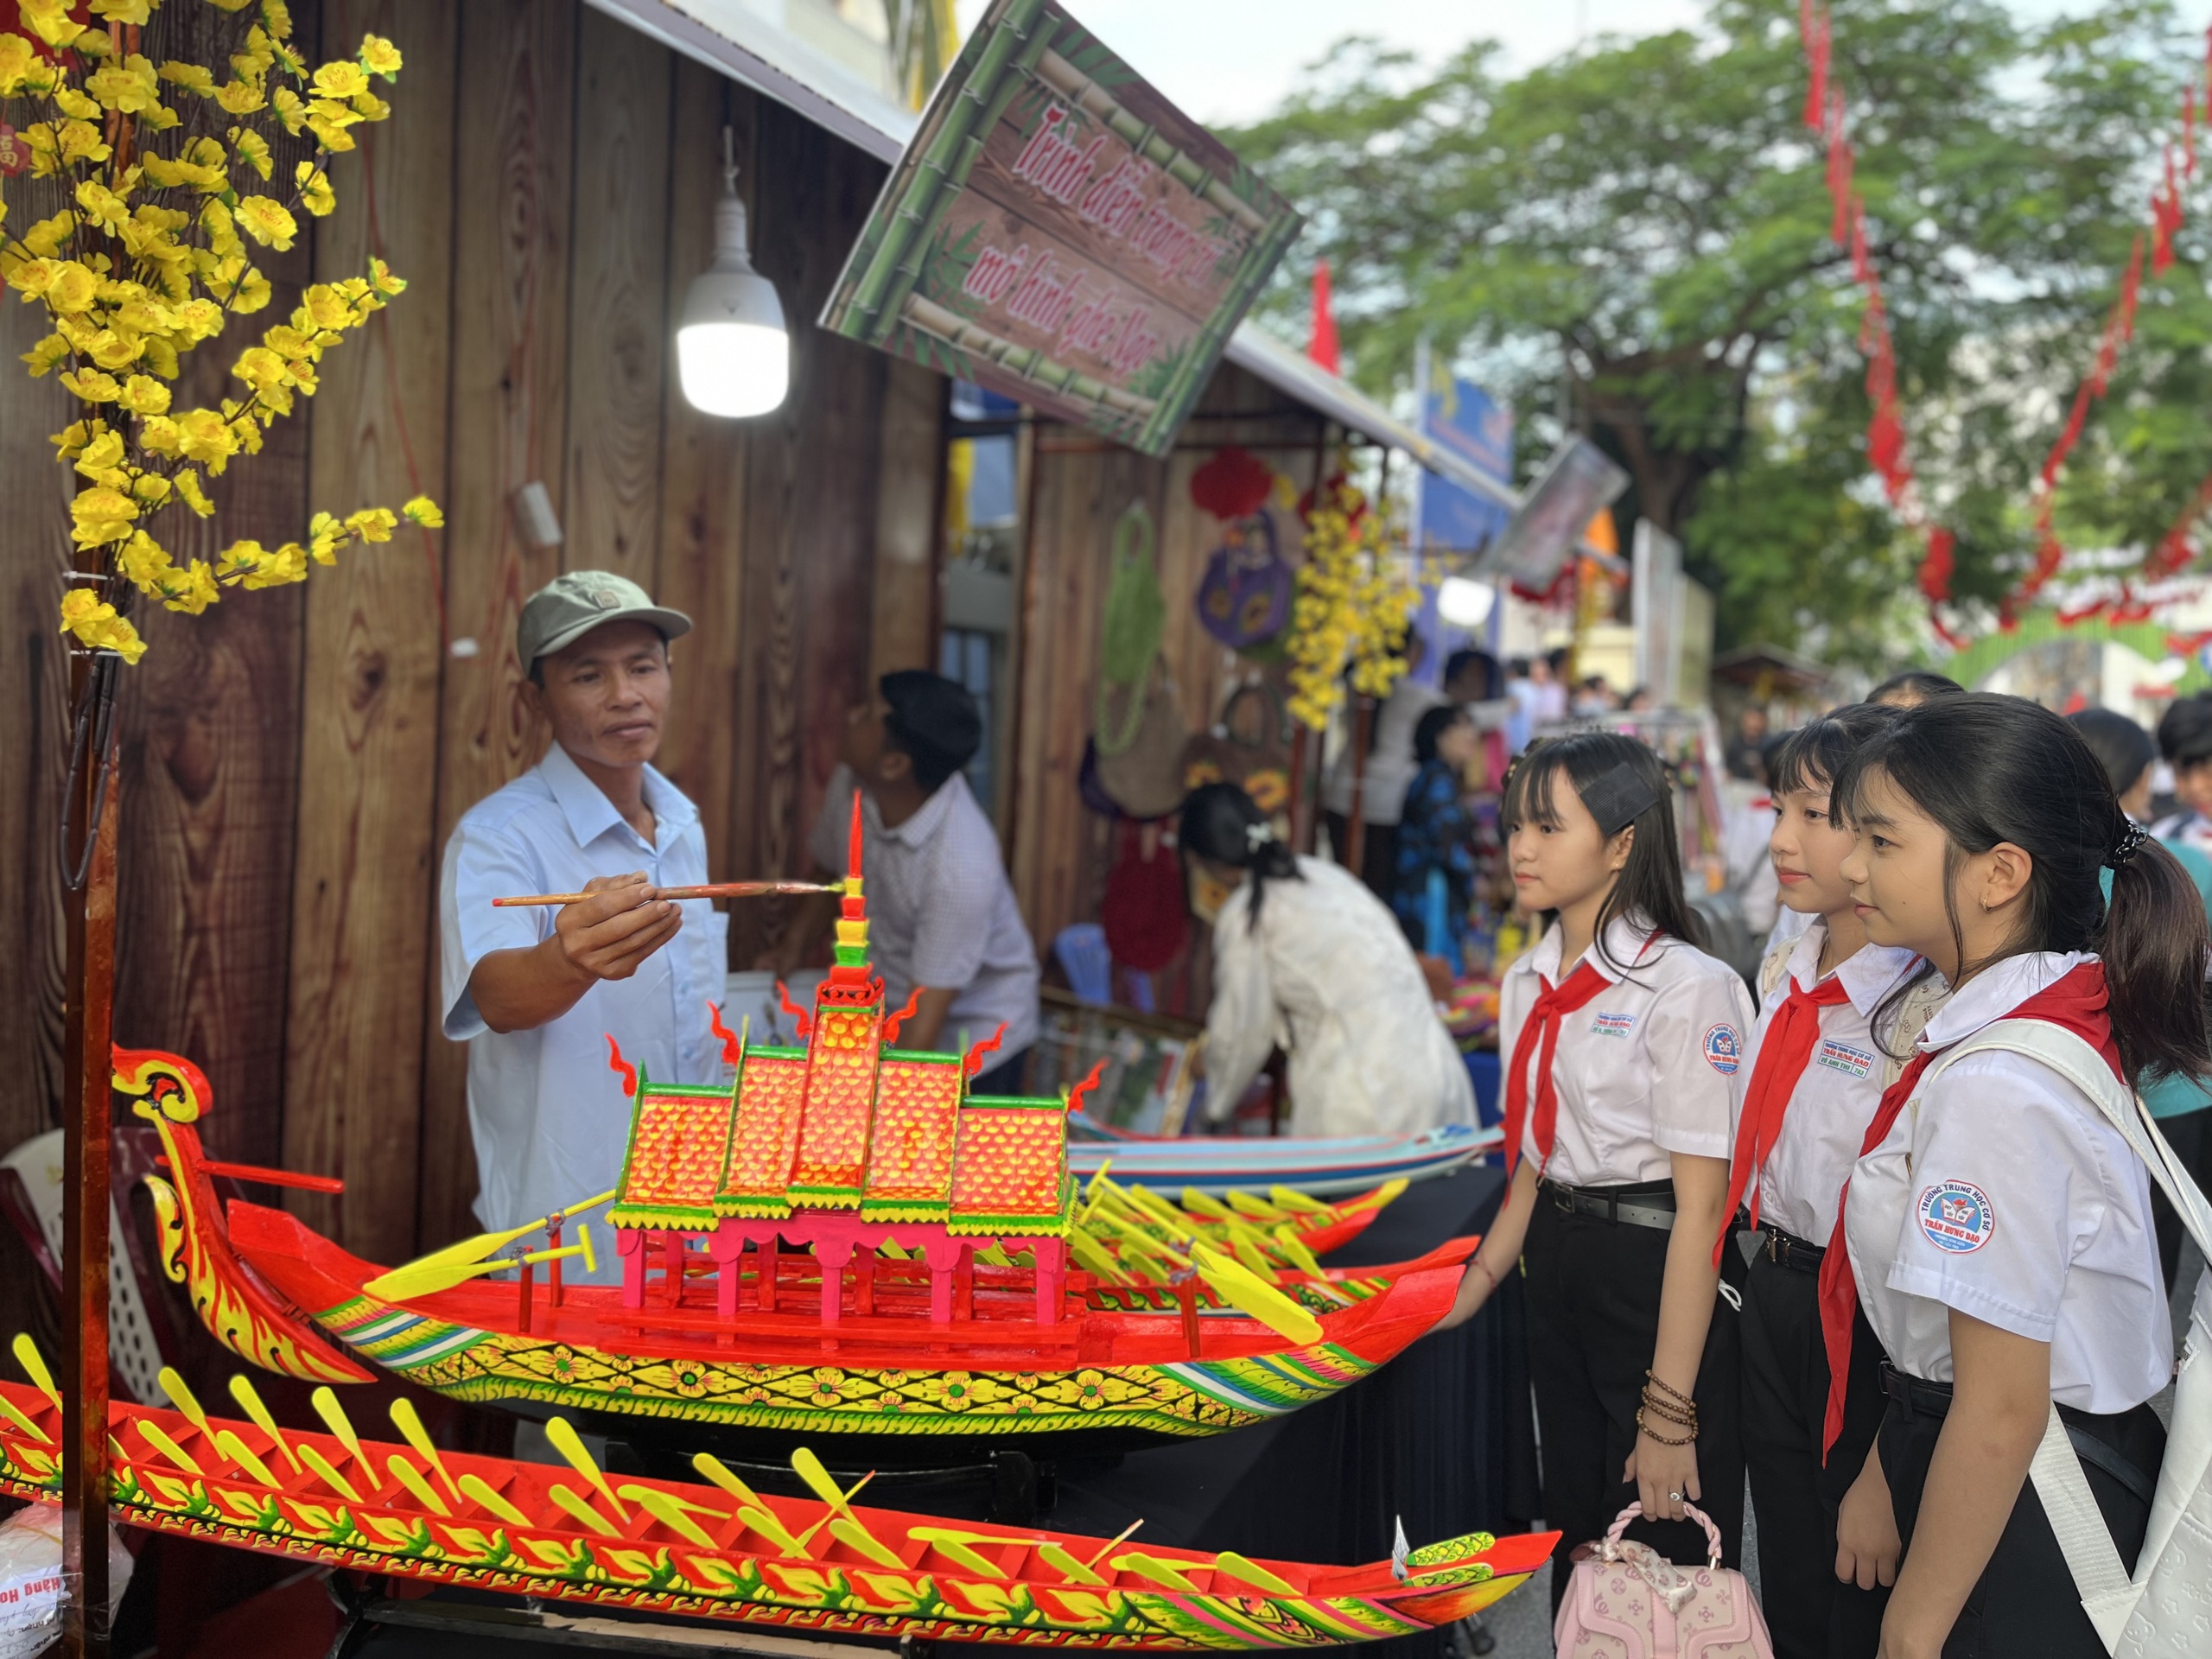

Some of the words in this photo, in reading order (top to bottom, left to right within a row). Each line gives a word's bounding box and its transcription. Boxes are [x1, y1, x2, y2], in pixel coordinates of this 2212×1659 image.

[1013, 101, 1108, 204] Trình
[1080, 154, 1153, 237] diễn
[963, 244, 1028, 305] mô
[1007, 249, 1089, 334] hình
[1943, 1184, 1972, 1194] TRUNG
[1972, 1191, 1986, 1207] HỌC
[24, 1577, 60, 1596] Hàng
